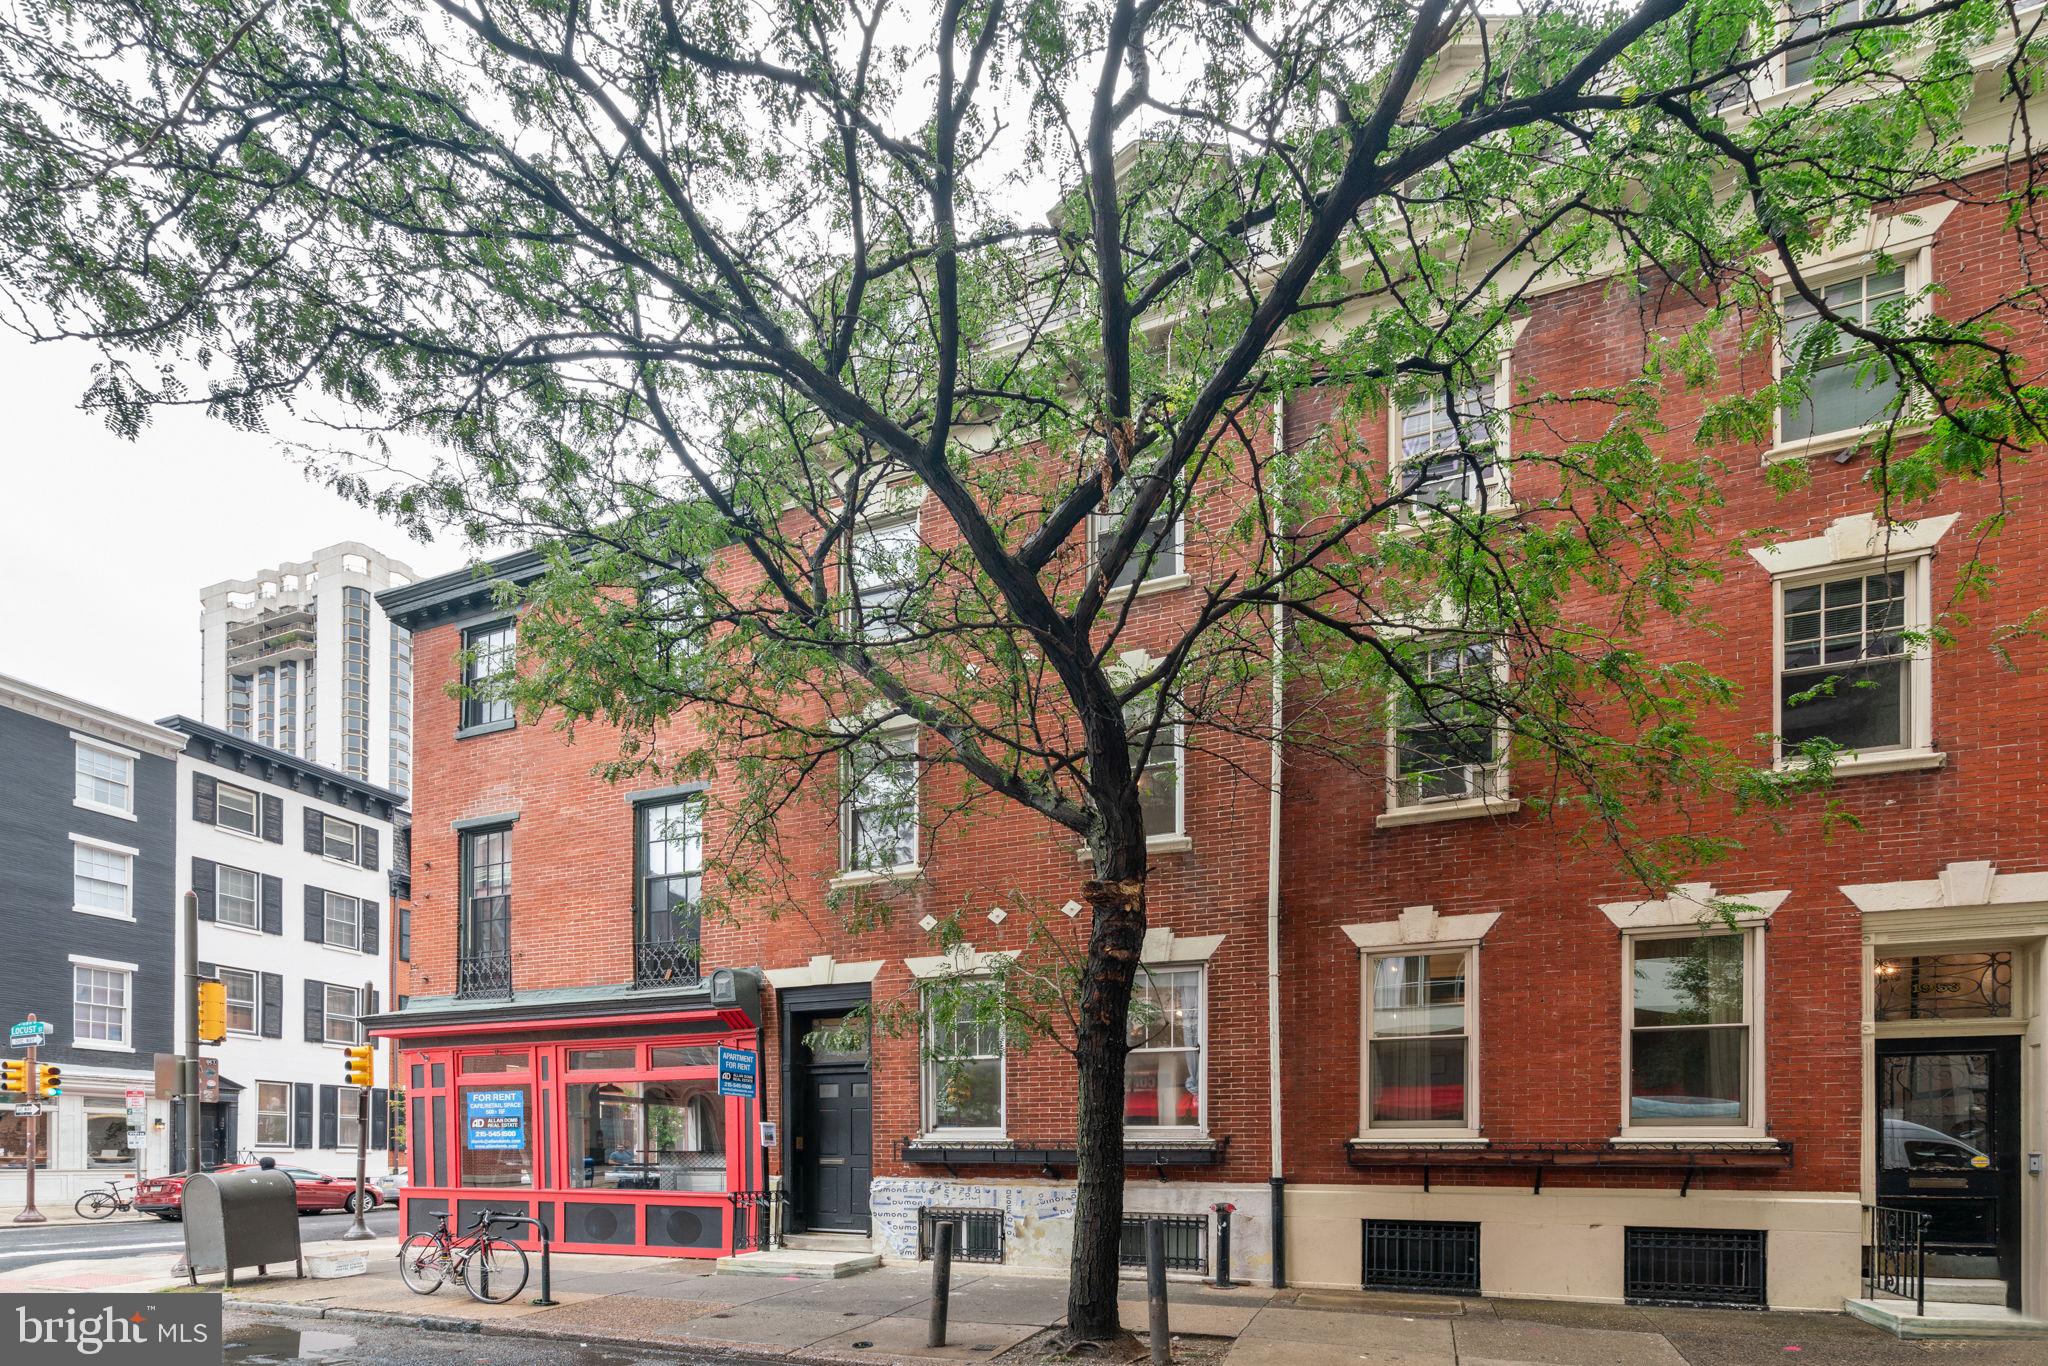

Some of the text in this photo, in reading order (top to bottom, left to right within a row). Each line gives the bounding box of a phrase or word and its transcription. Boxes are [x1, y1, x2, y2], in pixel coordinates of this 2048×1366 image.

[12, 1026, 37, 1036] LOCUST
[722, 1052, 754, 1063] APARTMENT
[726, 1061, 751, 1070] FOR RENT
